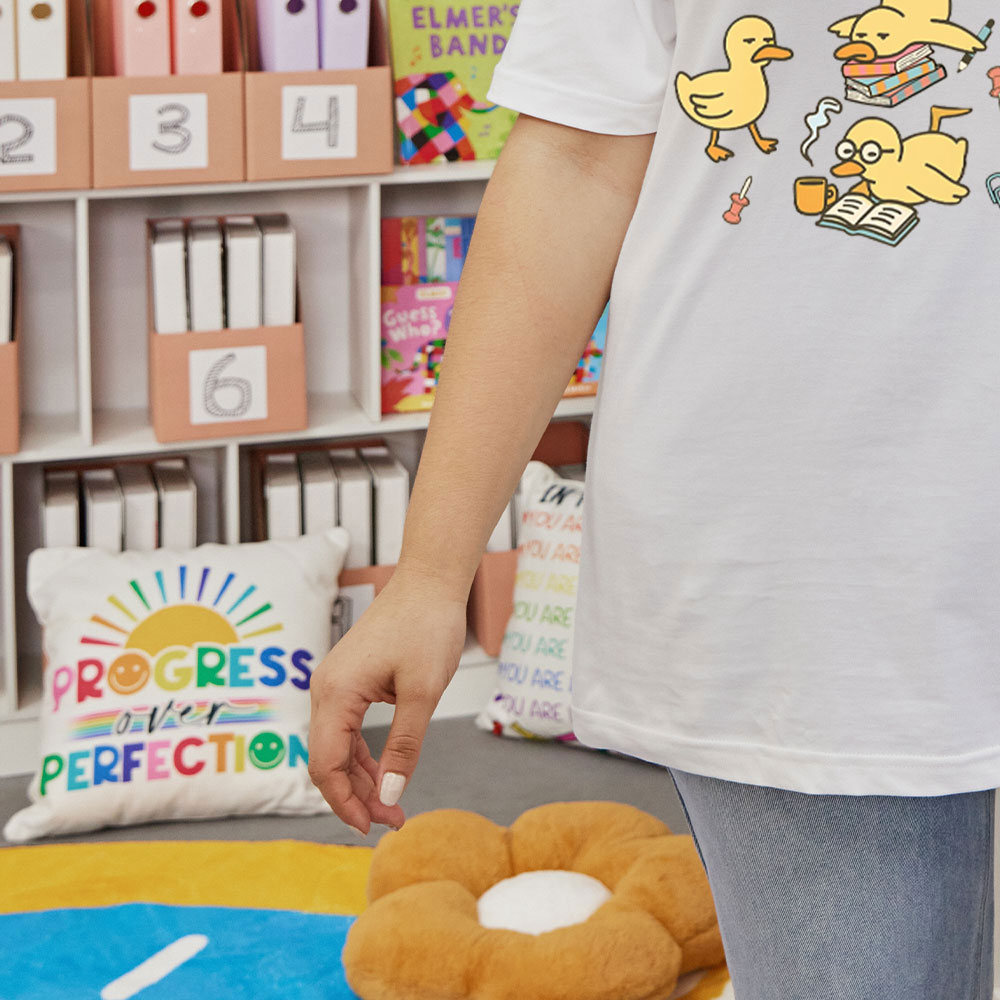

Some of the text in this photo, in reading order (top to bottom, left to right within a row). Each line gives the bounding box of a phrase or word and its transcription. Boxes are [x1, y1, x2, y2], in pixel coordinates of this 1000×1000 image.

[429, 33, 509, 59] BAND
[152, 102, 192, 155] 3
[291, 94, 341, 148] 4
[0, 113, 34, 164] 2
[382, 304, 438, 328] Guess
[386, 317, 443, 343] Who?
[204, 352, 253, 418] 6
[513, 600, 574, 628] OU ARE
[535, 635, 568, 660] ARE
[52, 646, 314, 713] PROGRESS
[531, 667, 565, 692] ARE
[115, 699, 245, 736] over
[529, 698, 562, 721] ARE
[40, 730, 310, 797] PERFECTION
